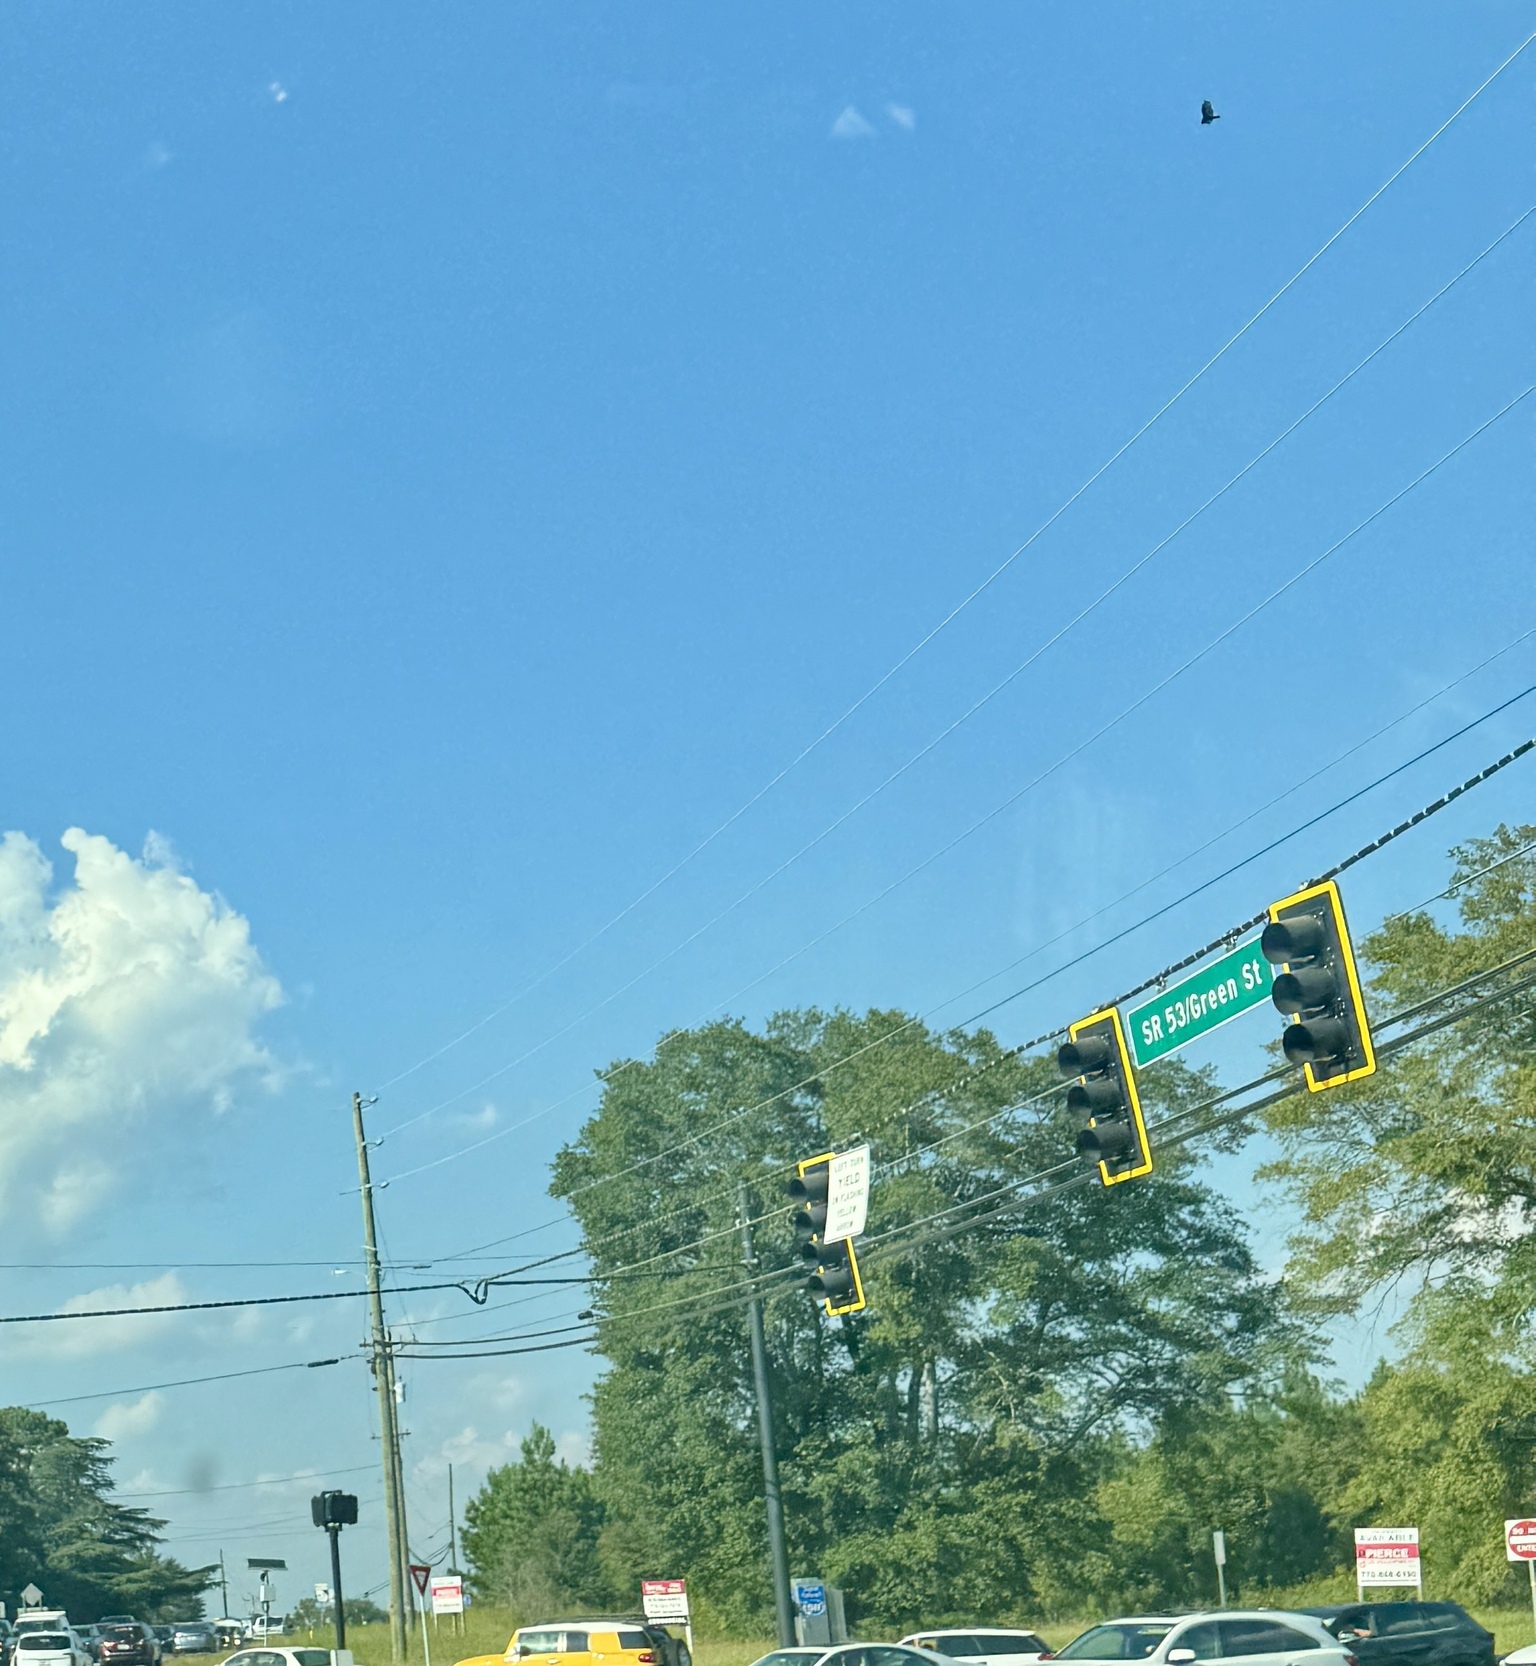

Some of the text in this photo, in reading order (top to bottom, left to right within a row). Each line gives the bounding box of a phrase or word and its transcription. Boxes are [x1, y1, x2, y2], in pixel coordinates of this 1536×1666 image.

[1142, 959, 1262, 1045] SR 53/Green St
[838, 1172, 860, 1188] YIELD
[1365, 1548, 1409, 1559] PIERCE
